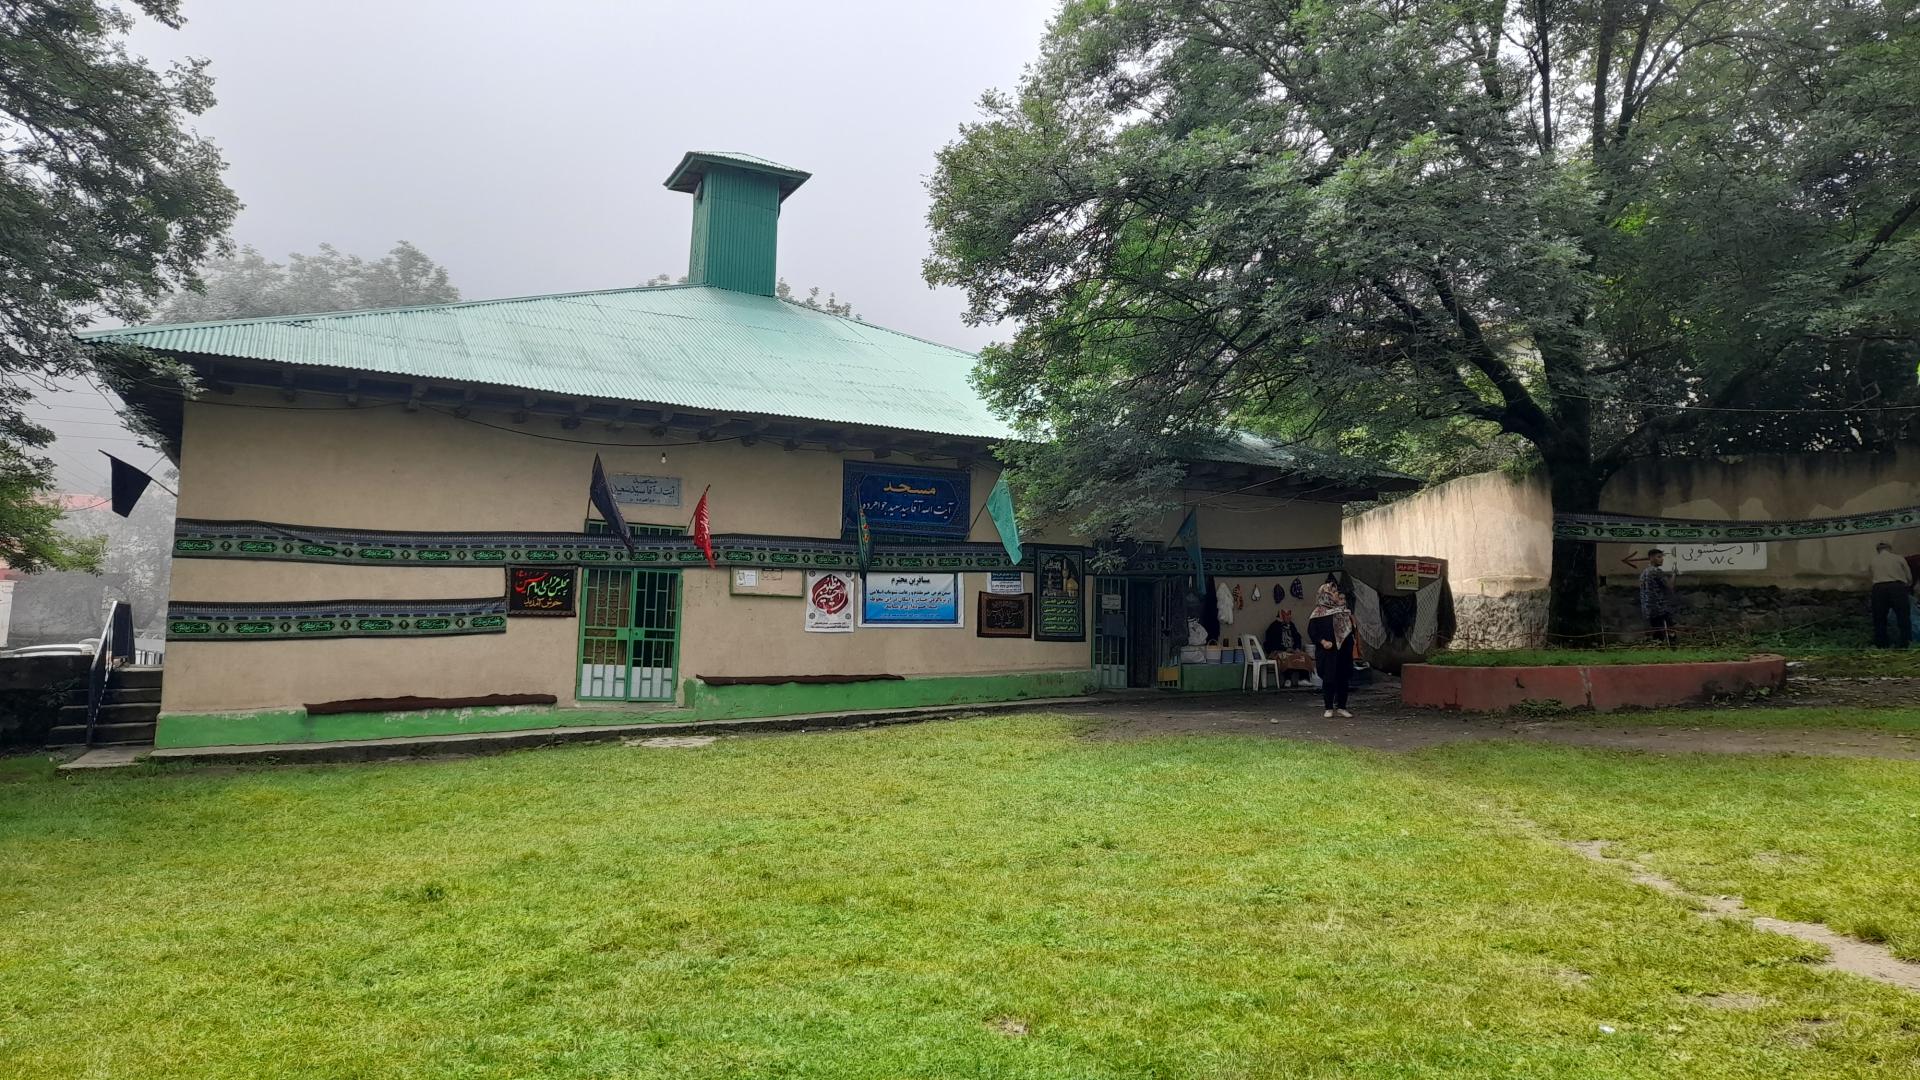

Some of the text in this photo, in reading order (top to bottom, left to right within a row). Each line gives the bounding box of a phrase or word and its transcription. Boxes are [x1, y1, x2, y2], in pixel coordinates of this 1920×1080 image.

[883, 480, 936, 498] مسجد
[888, 504, 902, 516] سعید
[900, 506, 911, 517] سید
[910, 500, 924, 513] آقا
[921, 504, 934, 513] الله
[933, 502, 954, 519] آیت
[514, 573, 549, 594] حسین
[526, 580, 545, 597] امام
[537, 576, 560, 596] عزای
[547, 573, 570, 597] مجلس
[891, 575, 930, 587] مسافرین محترم
[541, 597, 563, 609] خوش
